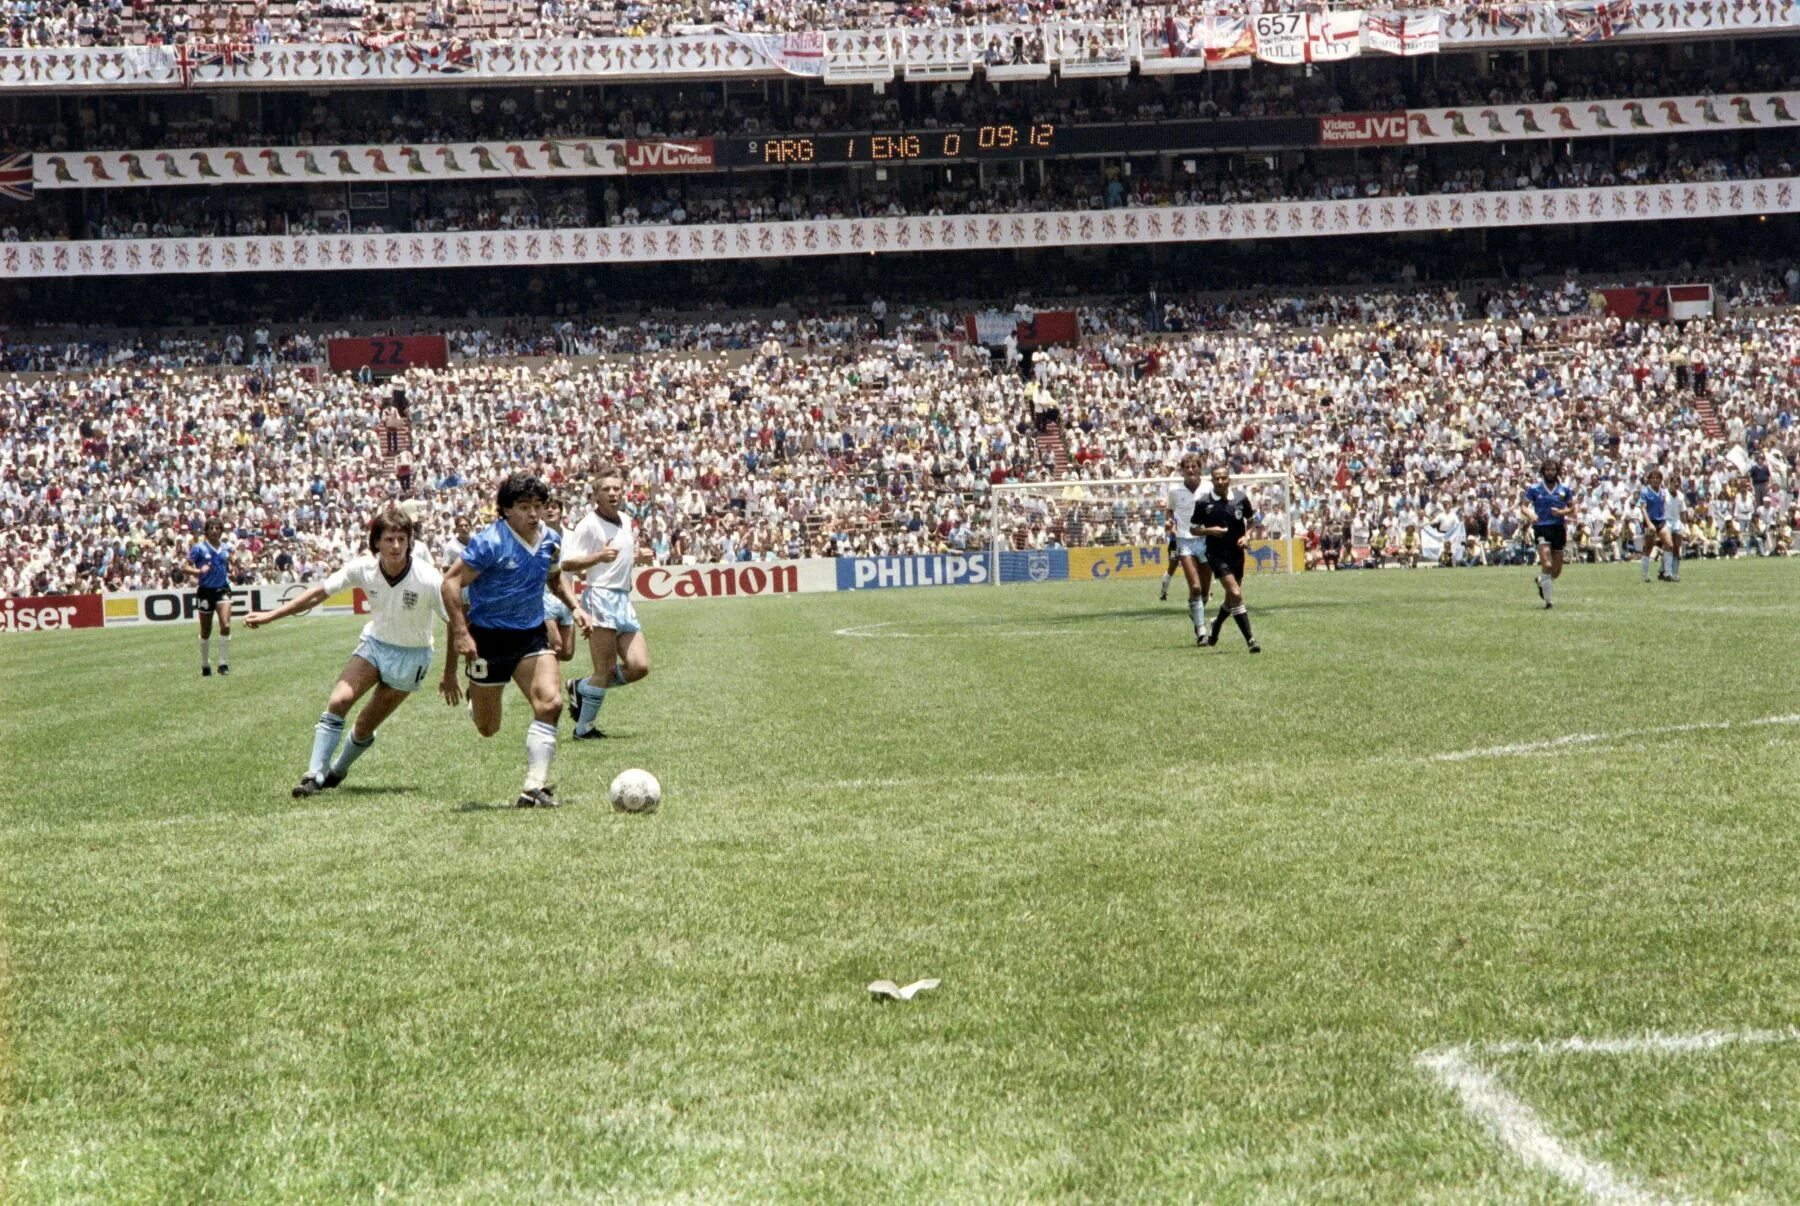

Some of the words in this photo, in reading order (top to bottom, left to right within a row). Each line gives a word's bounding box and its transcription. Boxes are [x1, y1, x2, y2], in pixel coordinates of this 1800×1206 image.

[1257, 15, 1300, 36] 657
[1259, 35, 1305, 45] PORTSMOUTH
[1323, 119, 1356, 130] Video
[1323, 130, 1358, 140] Movie
[1356, 117, 1405, 139] JVC
[765, 139, 813, 162] ARG
[848, 139, 853, 158] 1
[872, 136, 920, 158] ENG
[944, 134, 960, 155] 0
[979, 124, 1054, 147] 09:12
[629, 144, 679, 166] JVC
[679, 154, 712, 165] Video
[370, 341, 404, 364] 22
[855, 555, 987, 588] PHILIPS
[1091, 546, 1161, 578] CAM
[635, 564, 798, 600] Canon
[466, 658, 488, 679] 0
